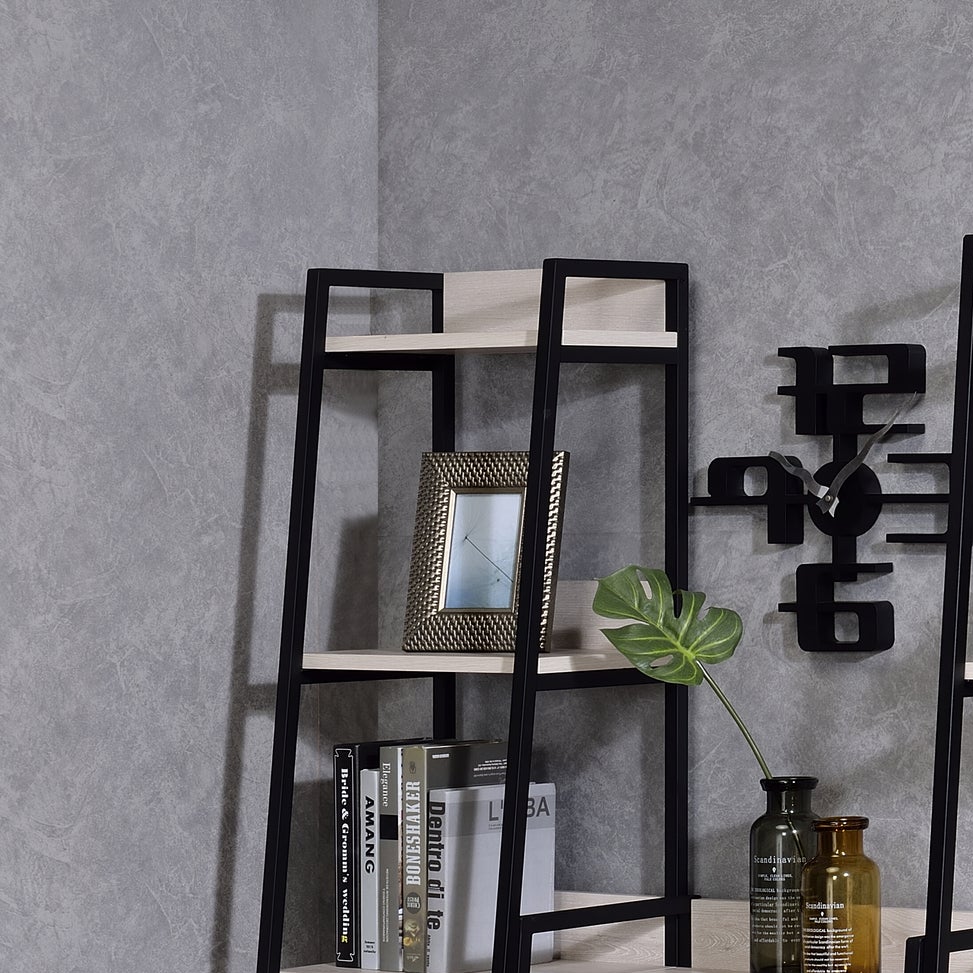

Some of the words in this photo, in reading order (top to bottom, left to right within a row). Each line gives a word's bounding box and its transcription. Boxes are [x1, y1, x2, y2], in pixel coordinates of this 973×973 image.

[340, 768, 349, 805] Bride
[381, 763, 391, 807] Elegance
[340, 808, 349, 821] &
[365, 796, 375, 874] AMANG
[405, 781, 421, 886] BONESHAKER
[428, 801, 446, 873] Dentro
[753, 855, 807, 864] Scandinavian
[428, 878, 445, 899] di
[805, 902, 845, 910] Scandinavian
[341, 888, 350, 944] wedding
[427, 909, 444, 930] te
